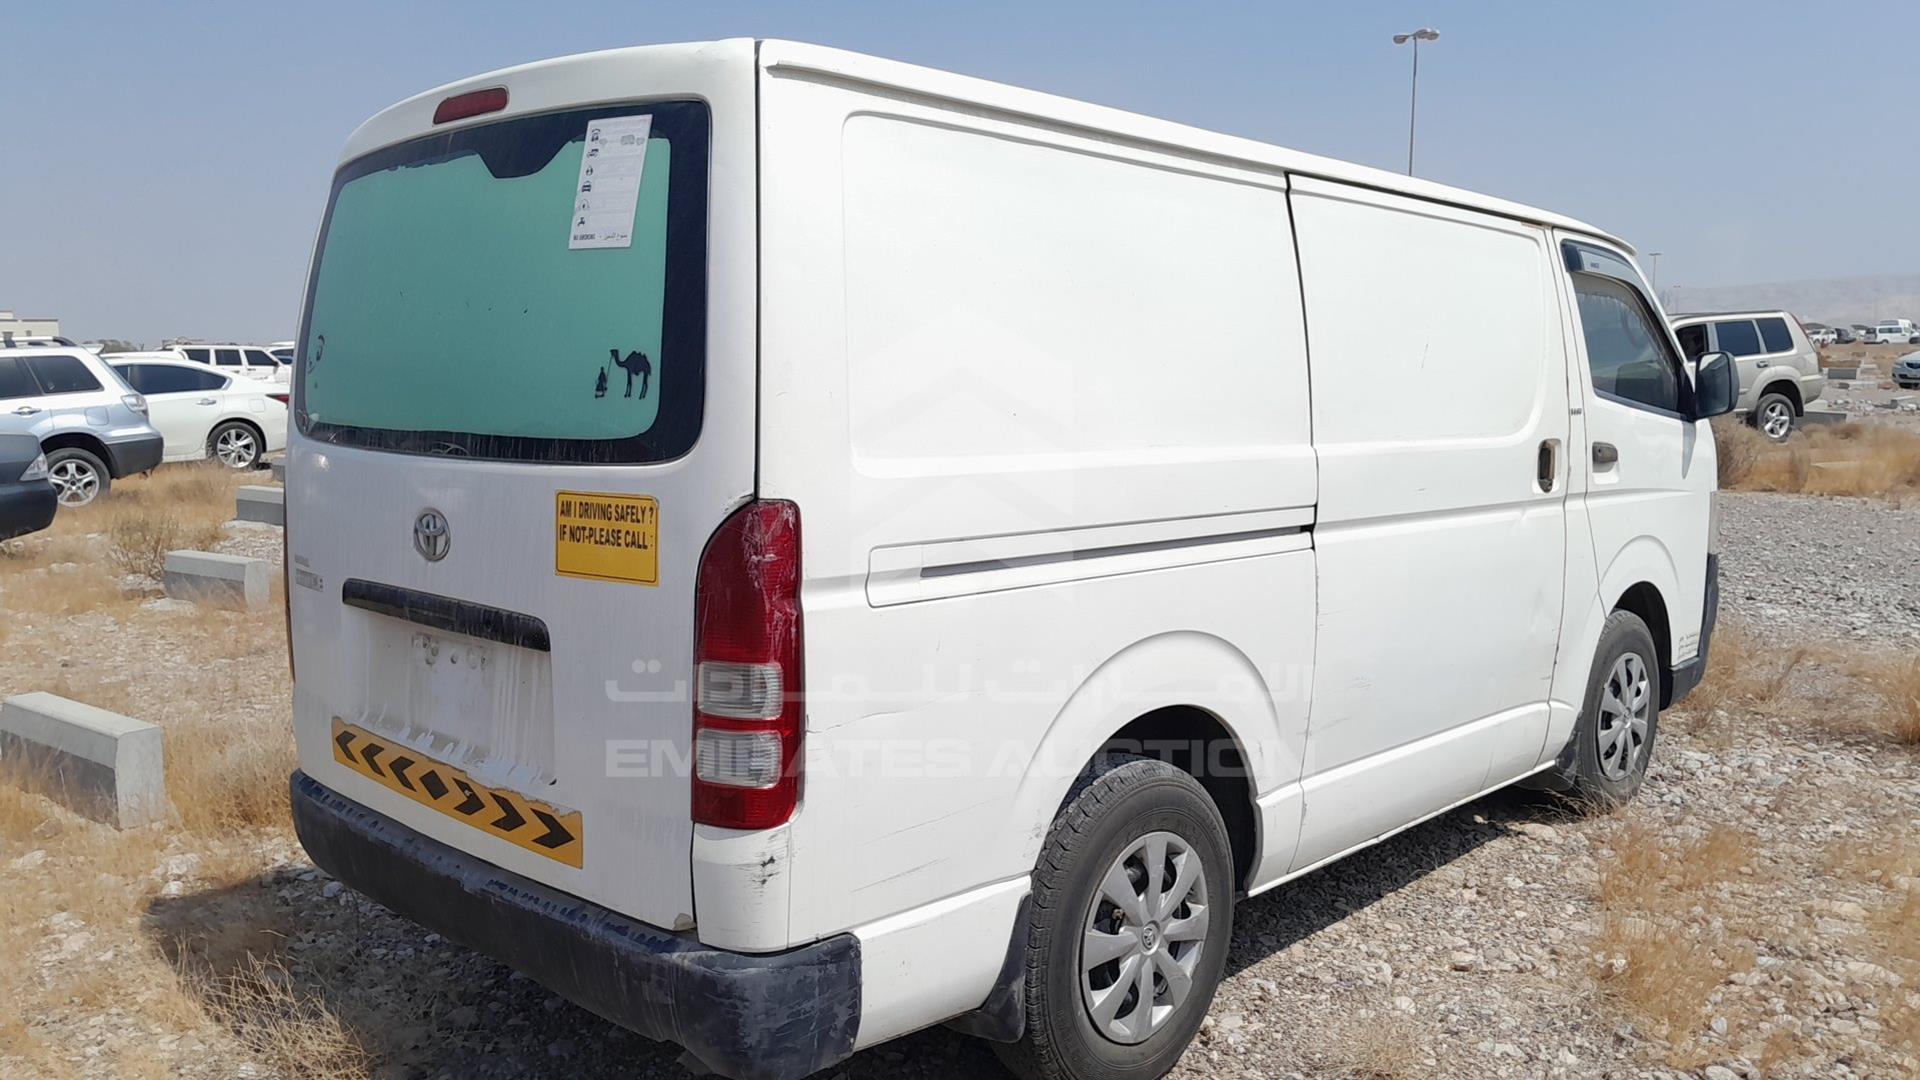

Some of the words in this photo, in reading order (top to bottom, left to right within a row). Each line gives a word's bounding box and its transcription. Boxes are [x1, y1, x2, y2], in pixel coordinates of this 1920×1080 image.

[560, 500, 572, 518] AM
[573, 501, 577, 518] I
[578, 501, 612, 522] DRIVING
[614, 503, 647, 524] SAFELY
[559, 524, 567, 542] IF
[569, 525, 622, 547] NOT-PLEASE
[624, 530, 648, 550] CALL
